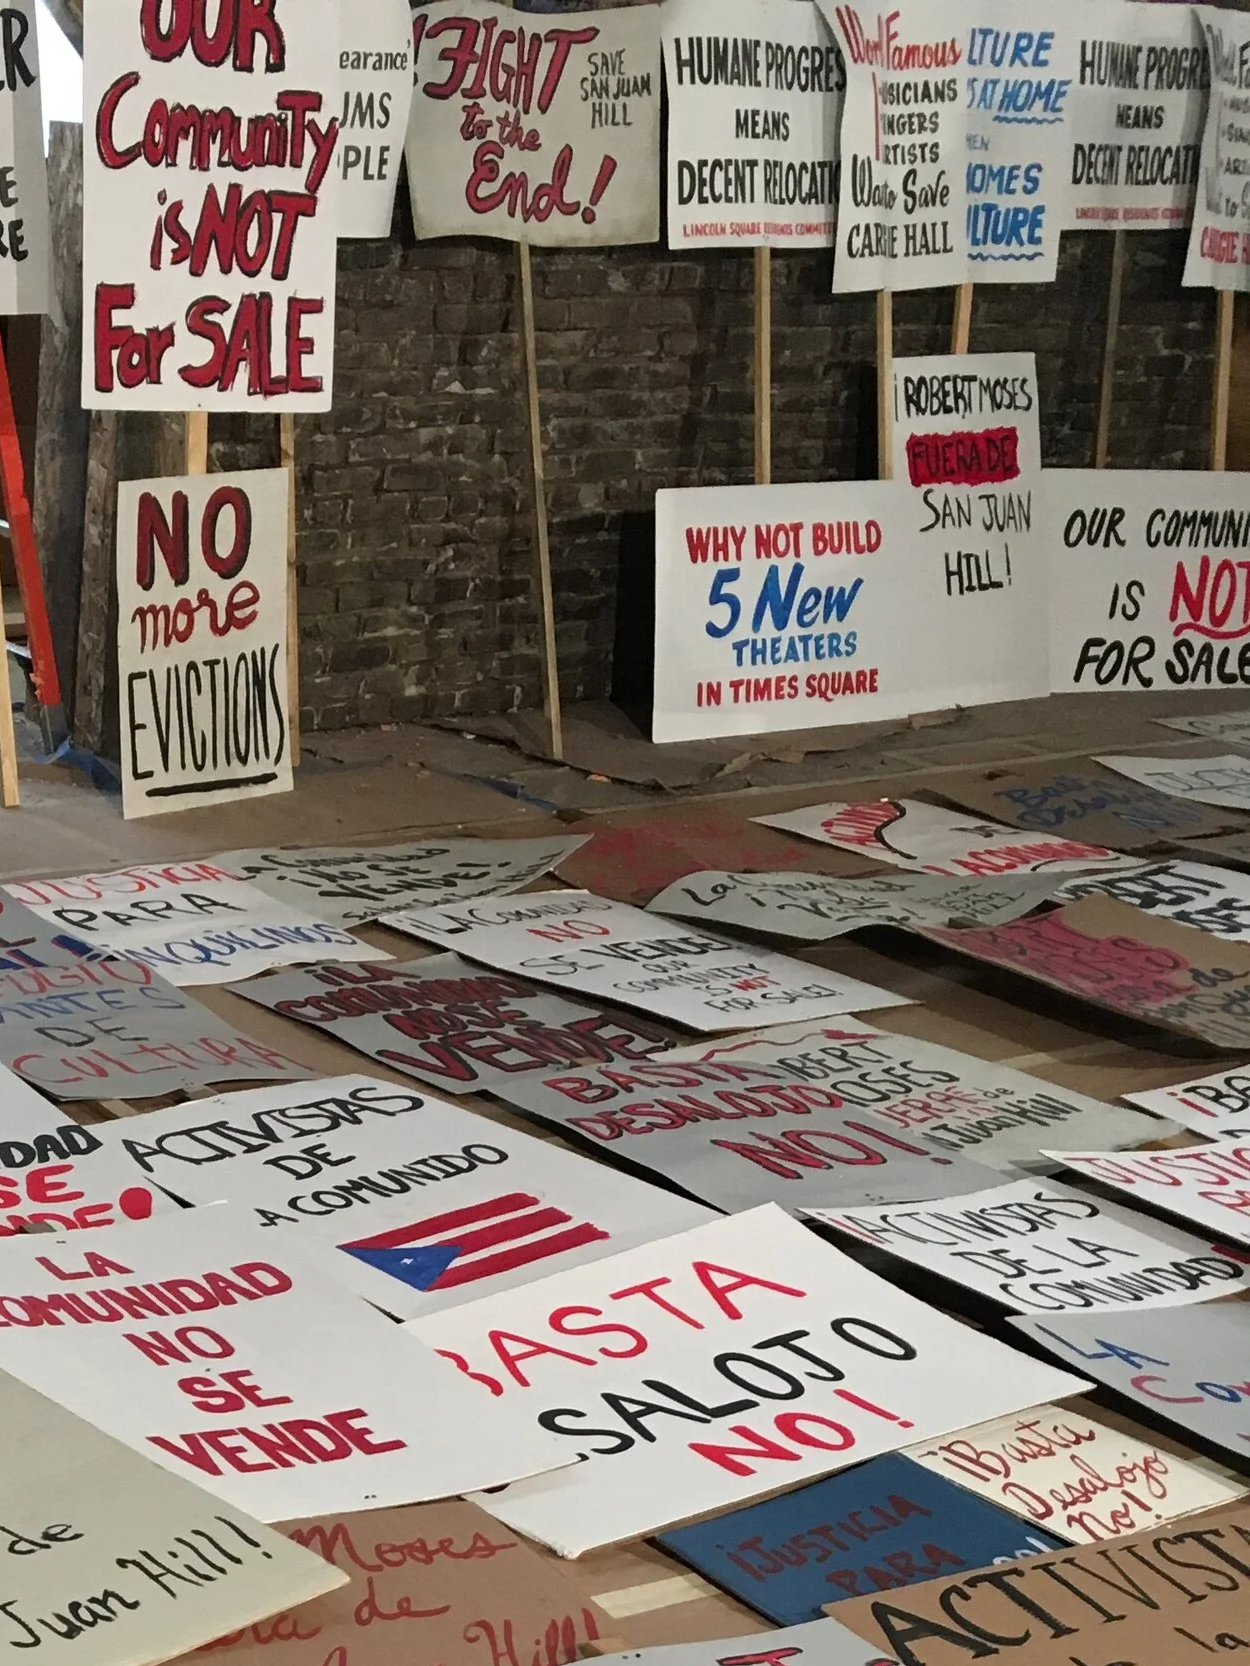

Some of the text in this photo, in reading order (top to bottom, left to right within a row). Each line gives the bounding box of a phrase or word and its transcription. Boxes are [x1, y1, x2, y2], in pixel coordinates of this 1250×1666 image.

[588, 49, 625, 76] SAVE
[675, 37, 761, 87] HUMANE
[580, 73, 651, 101] SAN JUAN
[997, 78, 1073, 115] HOME
[460, 102, 542, 151] to the
[591, 102, 633, 129] HILL
[735, 110, 790, 141] MEANS
[1116, 105, 1164, 130] MEANS
[678, 160, 759, 206] DECENT
[190, 183, 317, 280] NOT
[683, 223, 727, 238] LINCOLN
[730, 222, 761, 237] SQUARE
[904, 222, 953, 258] HALL
[178, 293, 324, 396] SALE
[979, 377, 1032, 412] MOSES
[910, 435, 1014, 481] FUERA DE
[920, 489, 1031, 532] SAN JUAN
[1063, 507, 1126, 548] OUR
[136, 485, 252, 591] NO
[686, 520, 882, 564] WHY NOT BUILD
[945, 542, 1012, 596] HILL!
[705, 567, 741, 638] 5
[1109, 580, 1145, 621] IS
[732, 631, 858, 667] THEATERS
[1073, 635, 1156, 688] FOR
[696, 668, 878, 707] IN TIMES SQUARE
[128, 643, 284, 780] EVICTIONS
[54, 893, 249, 931] PARA
[526, 920, 611, 944] NO
[519, 955, 605, 977] SE
[611, 963, 772, 994] COMMUNITY
[641, 959, 698, 974] OUR
[693, 975, 781, 997] IS NOT
[702, 992, 754, 1013] FOR
[35, 1016, 150, 1048] DE
[12, 1037, 316, 1083] CULTURA
[120, 1086, 425, 1174] ACTIVISTAS
[566, 1084, 844, 1141] DESALOJO
[263, 1143, 356, 1181] DE
[288, 1143, 509, 1217] COMUNIDO
[35, 1251, 136, 1281] LA
[950, 1237, 1140, 1280] DE LA
[1000, 1256, 1246, 1311] COMUNIDAD
[122, 1326, 237, 1366] NO
[1033, 1322, 1171, 1369] LA
[176, 1369, 294, 1413] SE
[144, 1408, 408, 1477] VENDE
[688, 1388, 915, 1478] NO!
[354, 1576, 452, 1627] de
